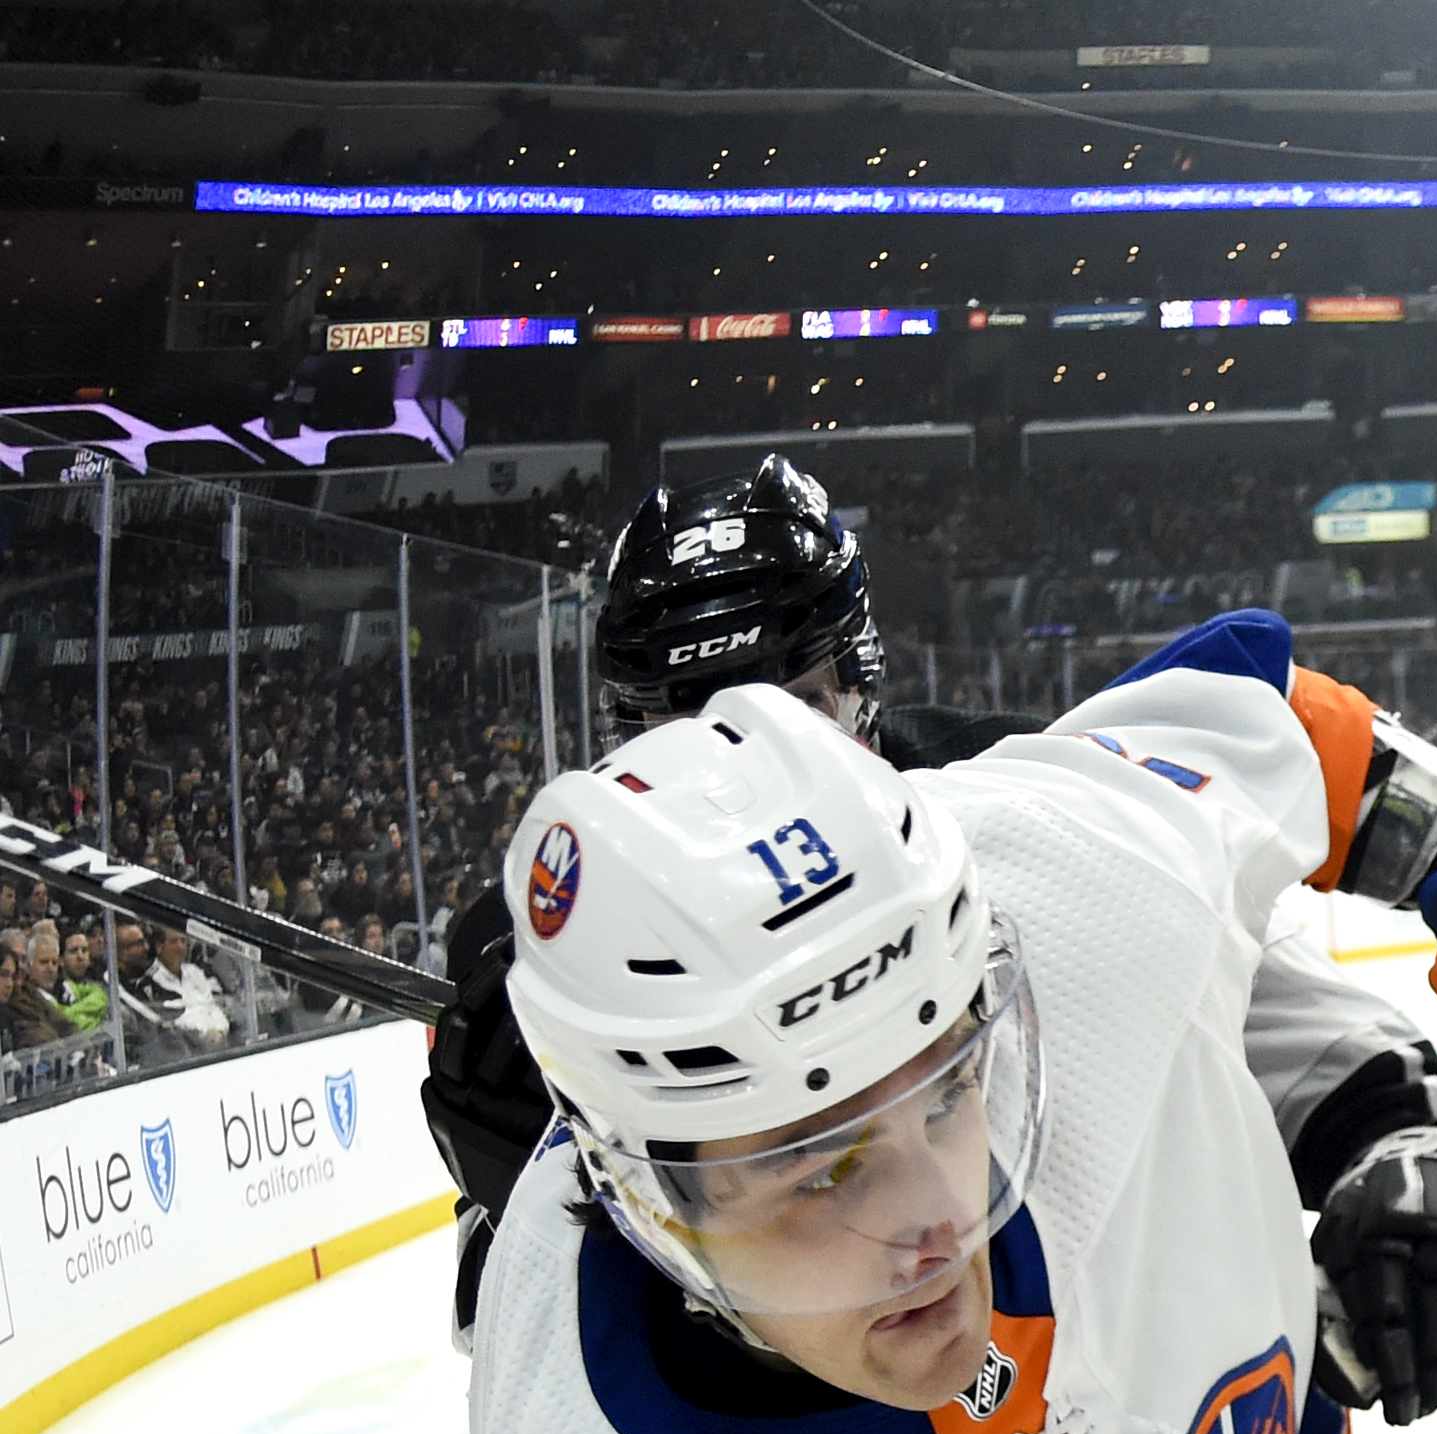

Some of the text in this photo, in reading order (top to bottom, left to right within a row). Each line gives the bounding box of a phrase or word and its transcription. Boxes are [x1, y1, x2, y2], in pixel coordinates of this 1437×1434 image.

[329, 324, 426, 348] STAPLES
[671, 518, 745, 566] 26
[53, 638, 88, 664] KINGS
[109, 635, 140, 662] INGS
[153, 632, 194, 660] KINGS
[668, 625, 762, 666] CCM
[748, 817, 841, 906] 13
[777, 924, 917, 1028] CCM
[220, 1091, 316, 1173] blue
[37, 1146, 133, 1243] blue
[245, 1155, 335, 1208] california
[66, 1220, 153, 1285] california
[977, 1357, 998, 1412] NHL
